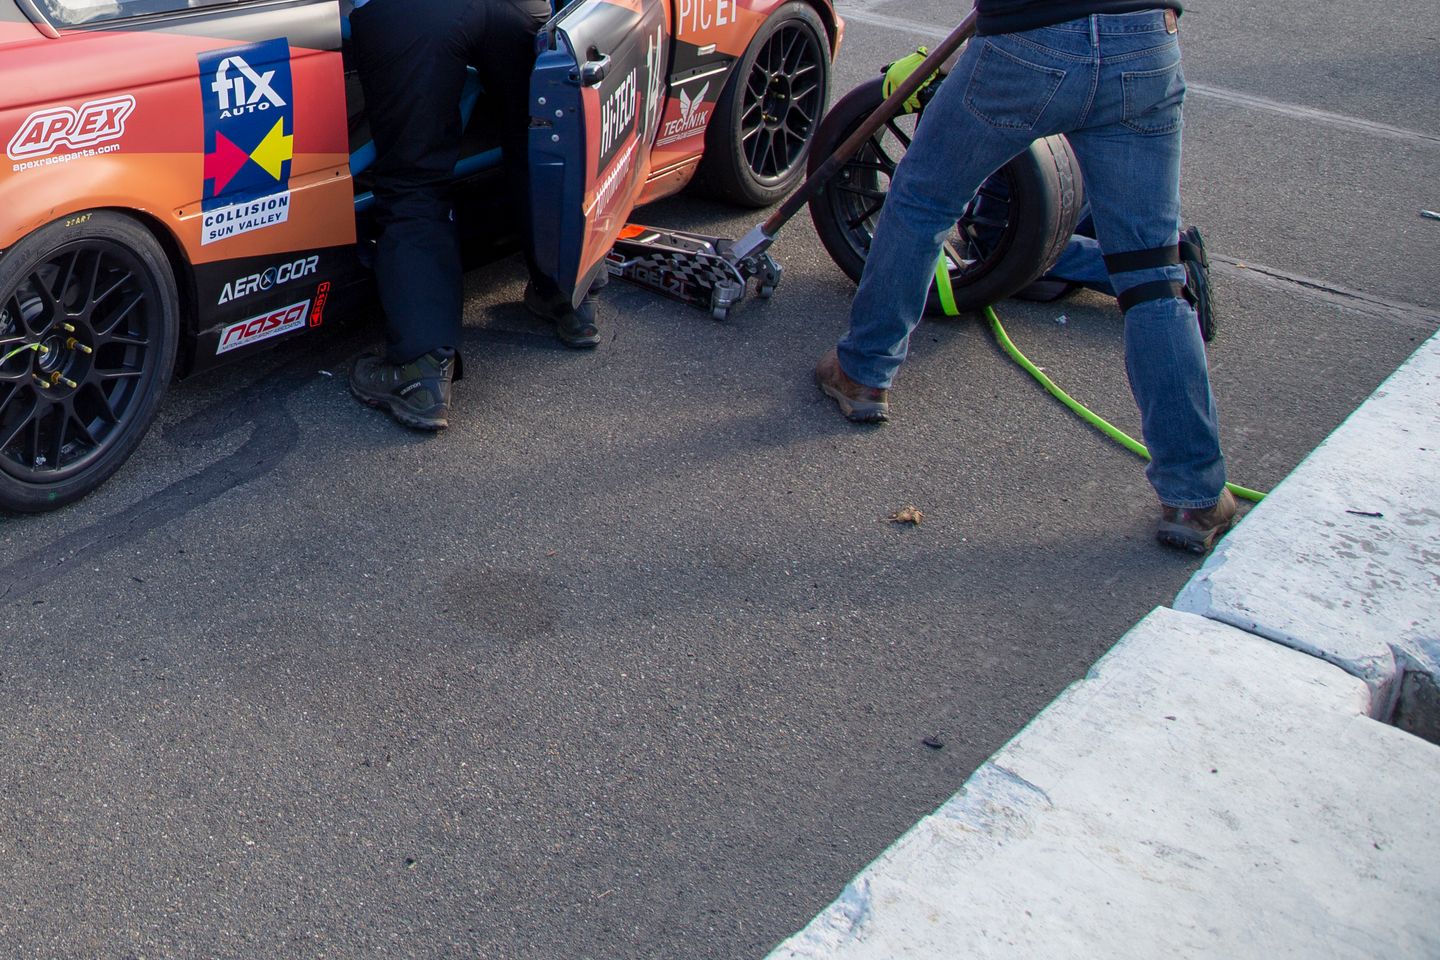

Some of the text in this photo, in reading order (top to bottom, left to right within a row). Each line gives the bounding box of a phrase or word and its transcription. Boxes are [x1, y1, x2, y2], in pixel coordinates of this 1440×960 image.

[219, 102, 270, 119] AUTO
[663, 110, 709, 137] TECHNIK
[13, 101, 130, 154] APEX
[12, 143, 121, 172] apexraceparts.com
[204, 195, 289, 228] COLLISION
[209, 212, 283, 240] SUN VALLEY
[222, 304, 307, 346] nasa
